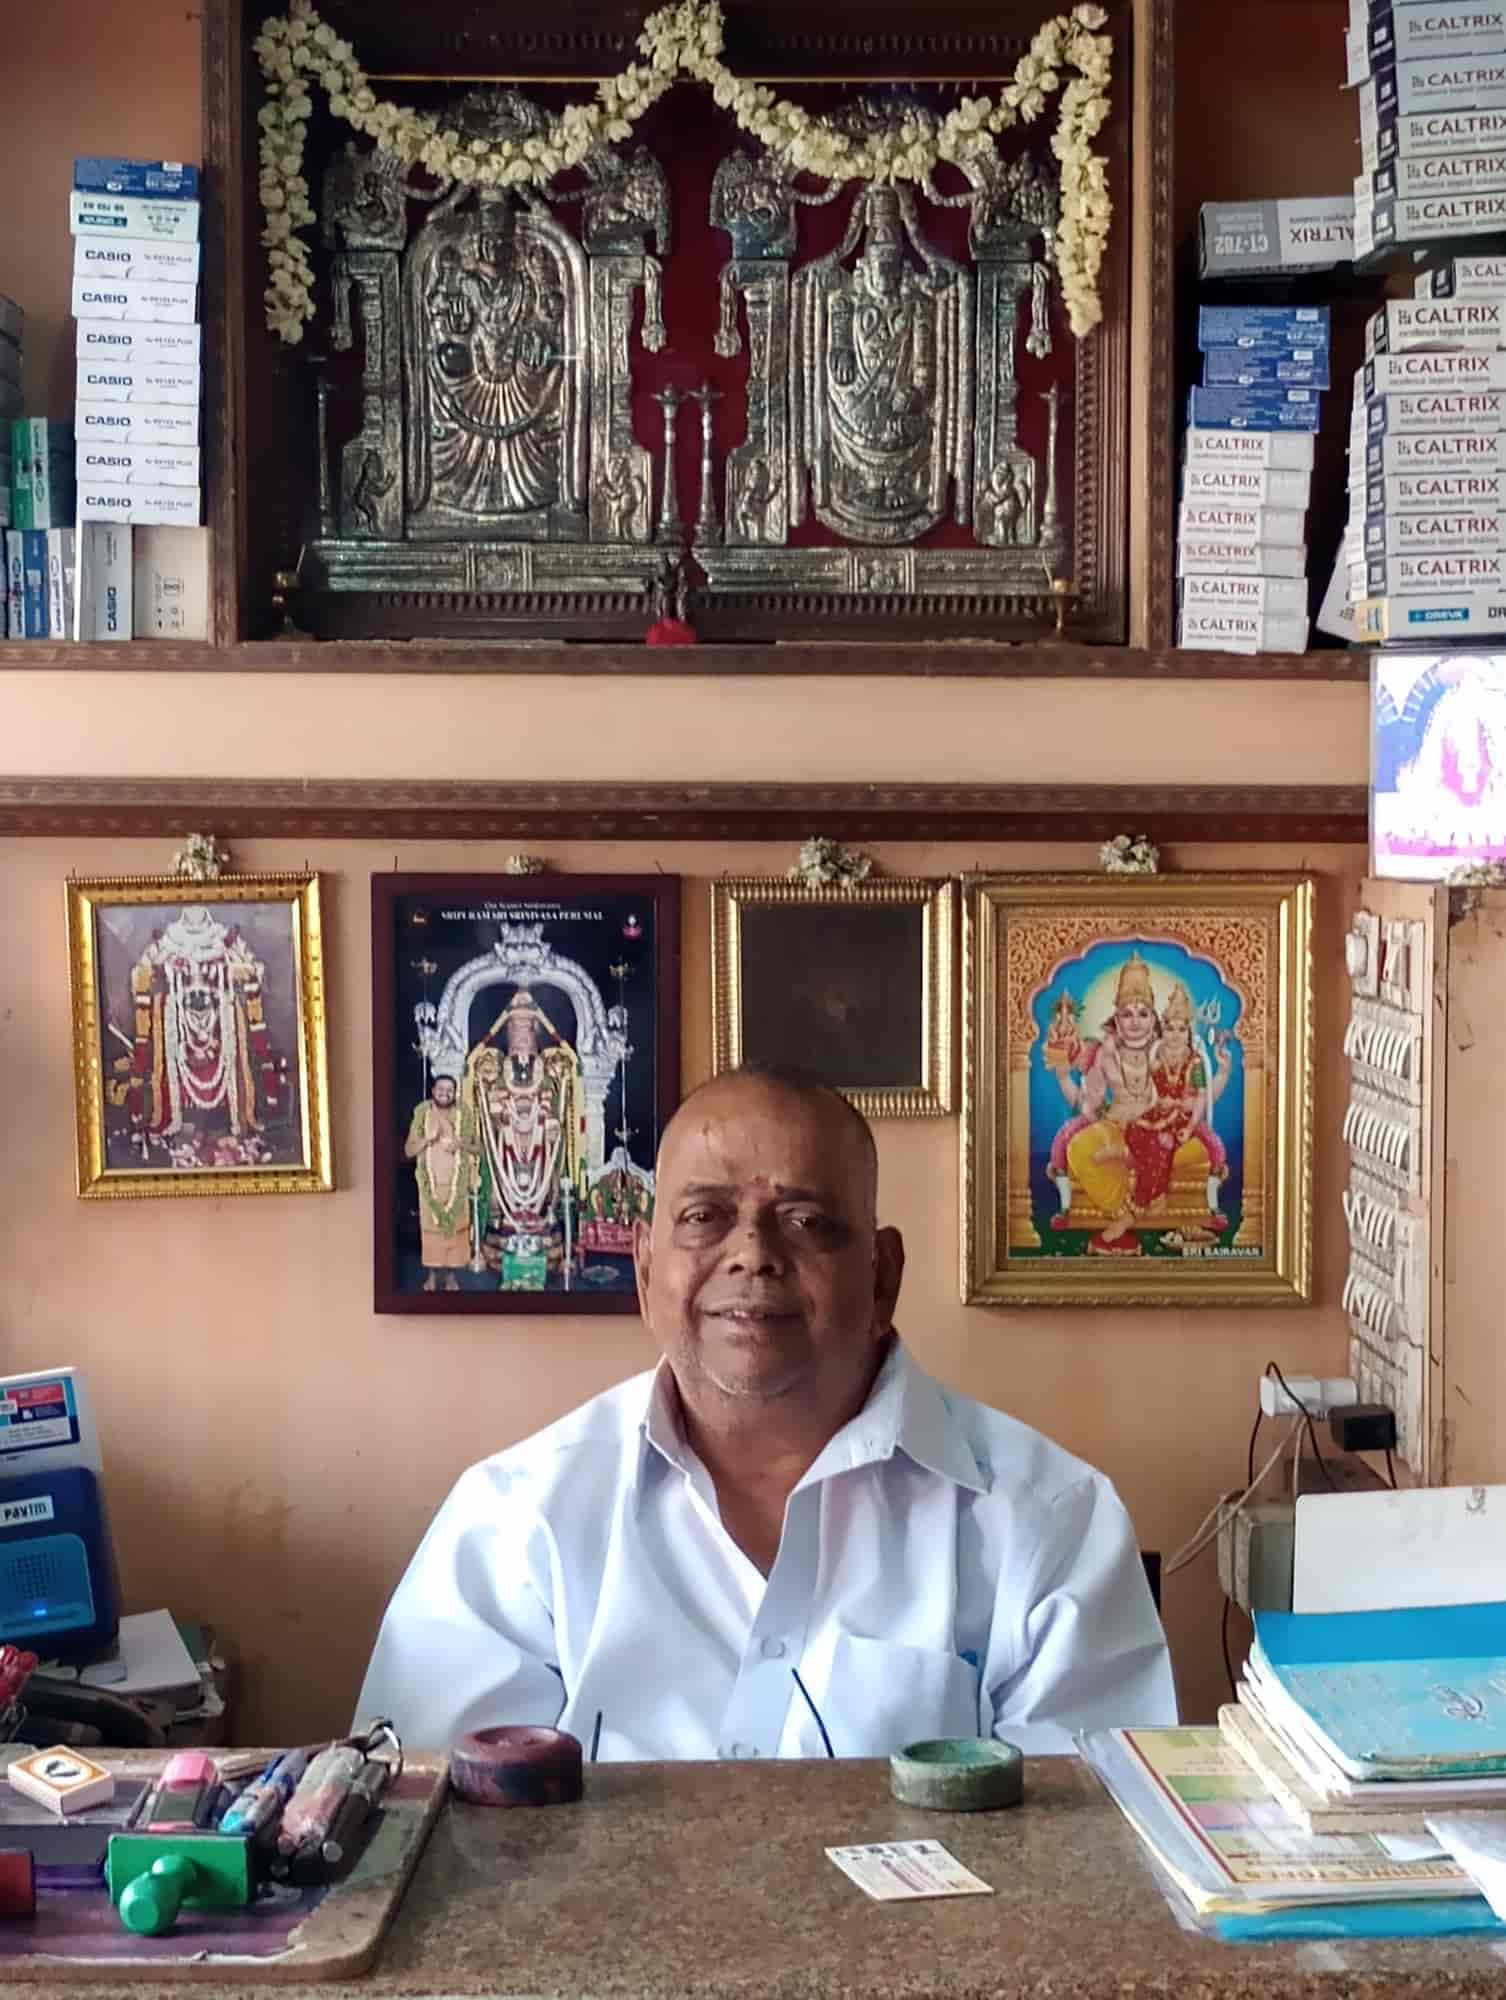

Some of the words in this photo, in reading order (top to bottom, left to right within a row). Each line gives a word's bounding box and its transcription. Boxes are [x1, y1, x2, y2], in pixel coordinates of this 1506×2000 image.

[1424, 13, 1503, 32] CALTRIX
[1427, 68, 1505, 87] CALTRIX
[1423, 158, 1506, 177] CALTRIX
[1423, 199, 1506, 218] CALTRIX
[85, 250, 131, 262] CASIO
[1474, 263, 1506, 277] CAL
[82, 292, 128, 304] CASIO
[1415, 306, 1499, 324] CALTRIX
[86, 334, 132, 345] CASIO
[1406, 357, 1489, 374] CALTRIX
[87, 375, 133, 386] CASIO
[1416, 397, 1500, 413] CALTRIX
[85, 416, 131, 426] CASIO
[1206, 438, 1264, 450] CALTRIX
[1414, 438, 1497, 455] CALTRIX
[86, 455, 132, 466] CASIO
[1202, 473, 1261, 487] CALTRIX
[1416, 478, 1499, 495] CALTRIX
[85, 496, 132, 508] CASIO
[1198, 511, 1256, 524] CALTRIX
[1416, 518, 1499, 534] CALTRIX
[1198, 545, 1256, 556] CALTRIX
[1417, 559, 1501, 576] CALTRIX
[1202, 581, 1260, 594] CALTRIX
[107, 586, 117, 632] CASIO
[1200, 618, 1258, 632] CALTRIX
